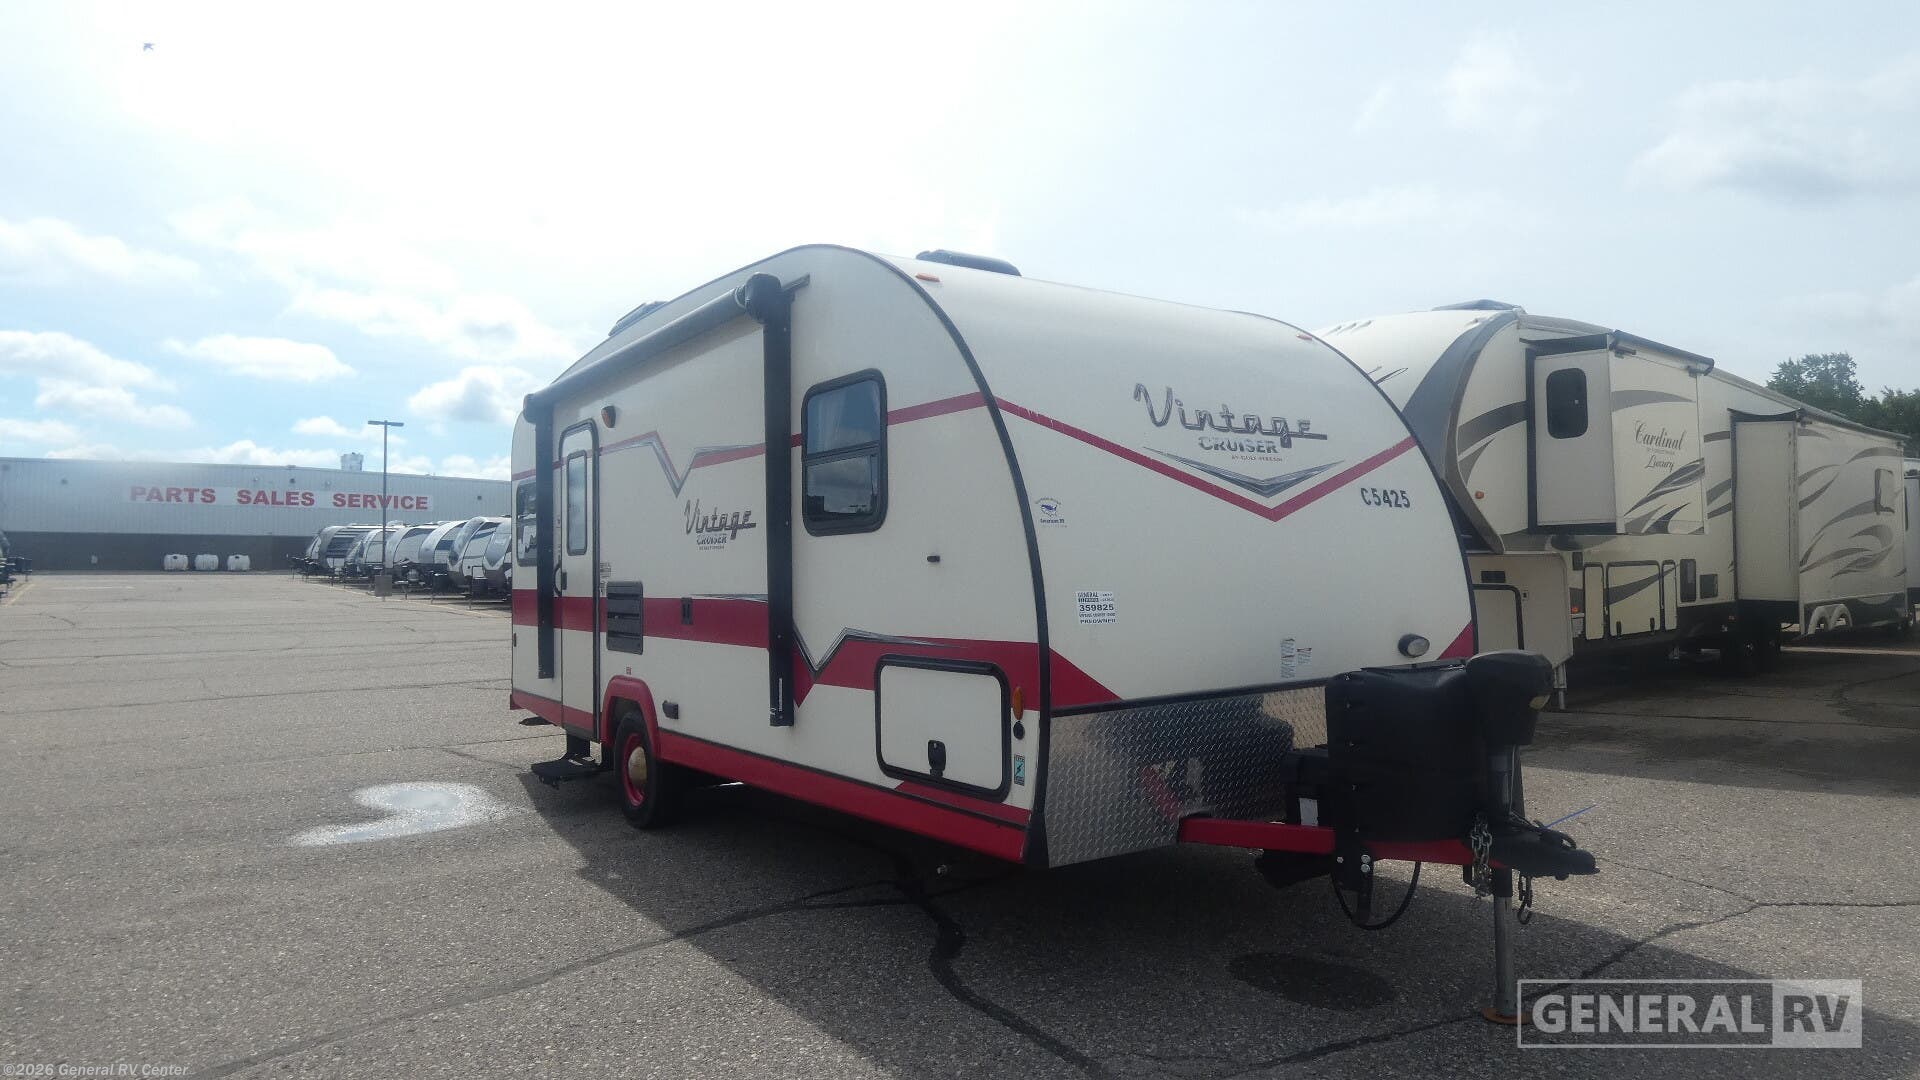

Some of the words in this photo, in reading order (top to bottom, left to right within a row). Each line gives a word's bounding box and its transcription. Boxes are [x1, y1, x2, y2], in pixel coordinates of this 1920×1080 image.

[1134, 383, 1328, 448] Vintage
[1198, 436, 1279, 454] CRUISER
[1632, 419, 1687, 450] Cardinal
[130, 486, 216, 503] PARTS
[236, 489, 315, 507] SALES
[332, 493, 428, 510] SERVICE
[1360, 487, 1411, 508] C5425
[684, 498, 757, 540] Vintage
[1079, 603, 1114, 612] 359825
